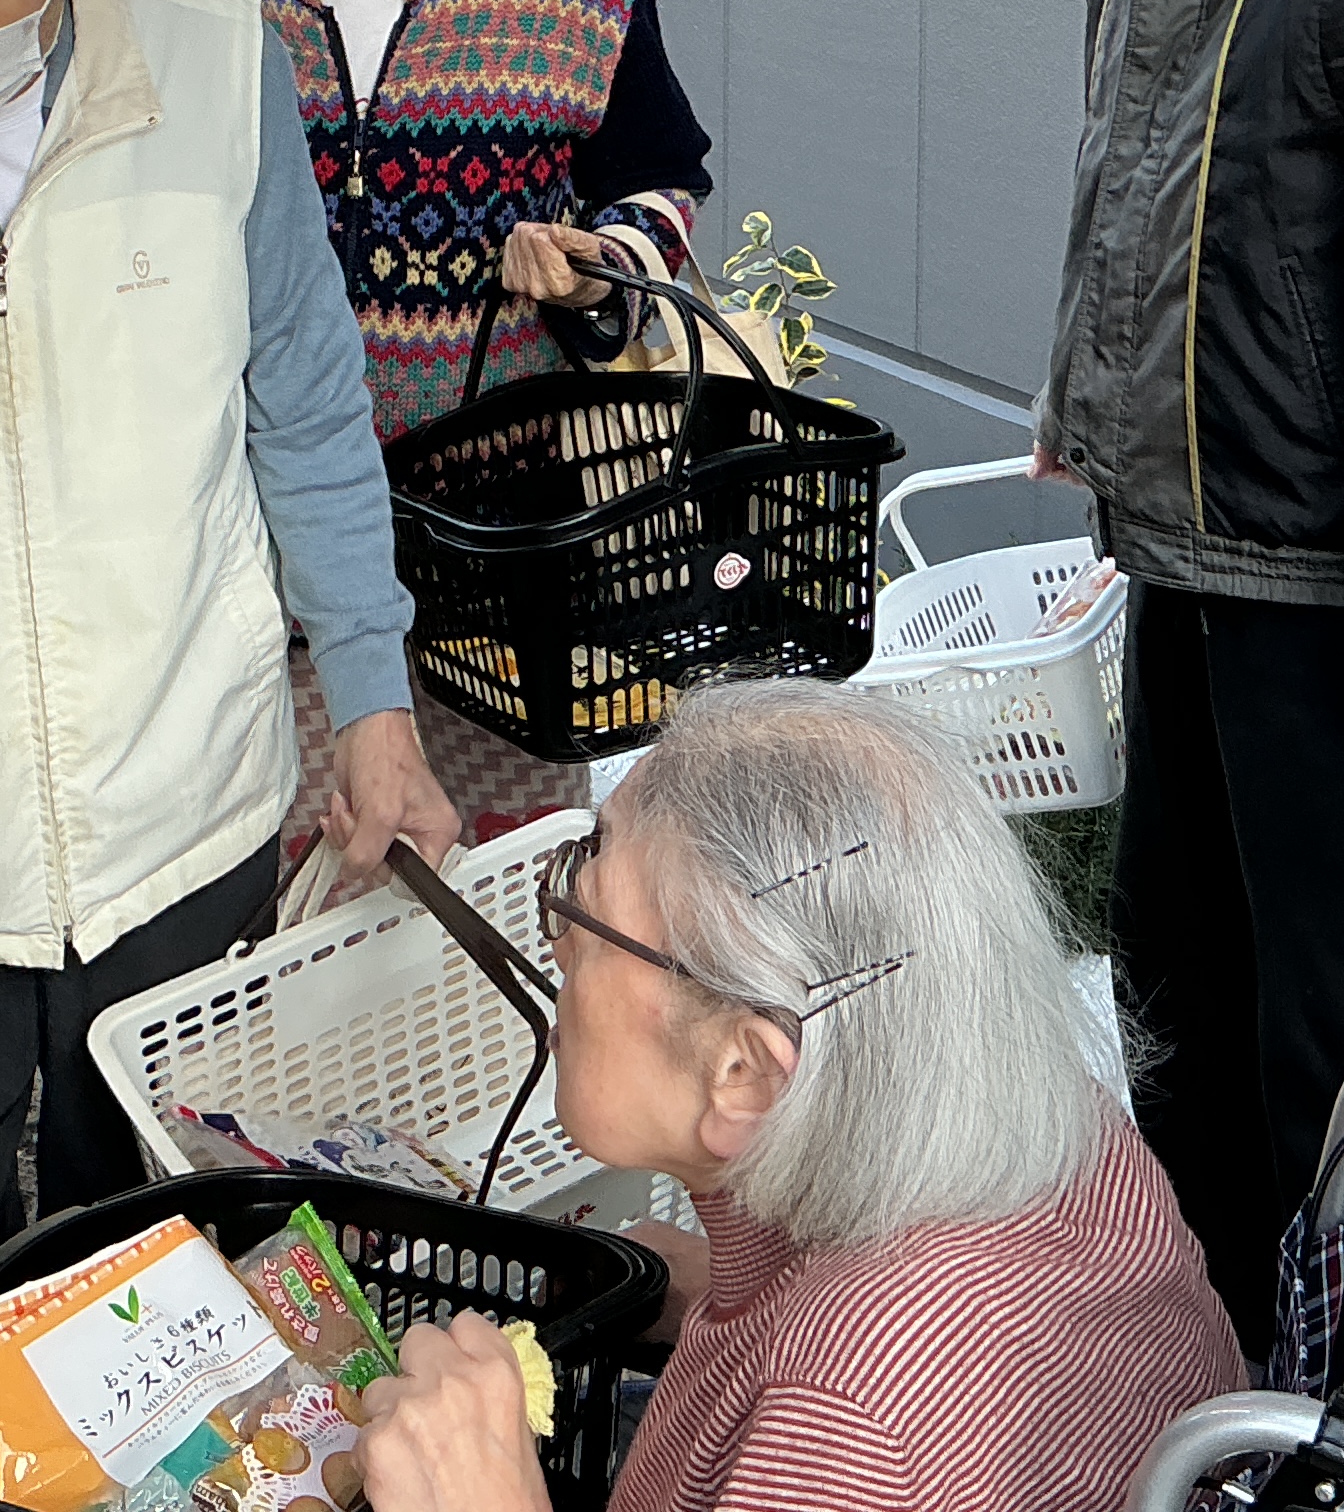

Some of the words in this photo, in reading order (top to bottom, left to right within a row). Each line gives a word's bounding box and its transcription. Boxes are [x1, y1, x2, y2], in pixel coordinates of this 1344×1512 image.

[77, 1299, 263, 1437] ミックスビスケット
[103, 1304, 216, 1390] おいしさ6種類
[140, 1376, 183, 1417] MIXED
[181, 1349, 232, 1381] BISCUITS
